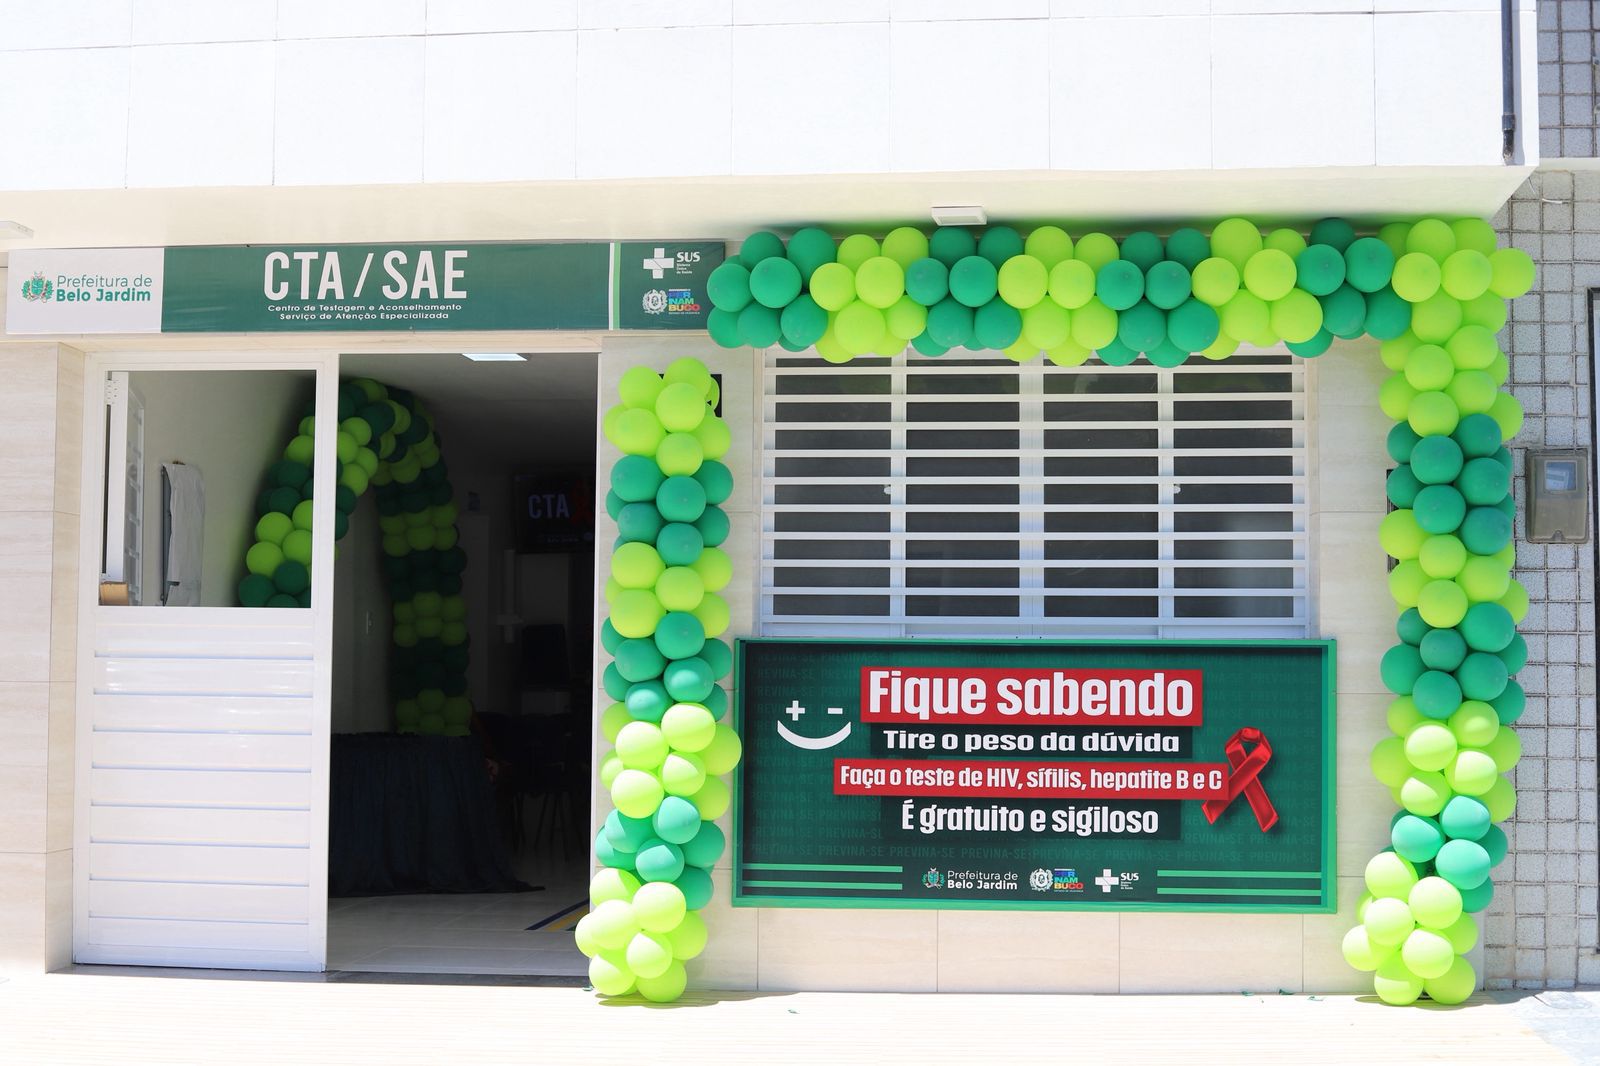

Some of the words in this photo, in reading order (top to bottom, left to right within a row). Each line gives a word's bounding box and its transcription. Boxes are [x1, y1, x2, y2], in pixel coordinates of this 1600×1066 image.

[677, 252, 700, 262] SUS
[57, 274, 128, 288] Prefeitura
[133, 274, 152, 288] de
[264, 251, 345, 301] CTA
[353, 253, 374, 298] /
[382, 250, 468, 300] SAE
[56, 288, 91, 302] Belo
[96, 288, 151, 302] Jardim
[268, 304, 300, 312] Centro
[319, 304, 365, 313] Testagem
[378, 303, 462, 312] Aconselhamento
[280, 312, 316, 321] Serviço
[319, 312, 332, 320] de
[335, 312, 377, 321] Atenção
[380, 312, 449, 321] Especializada
[528, 494, 570, 519] CTA
[870, 670, 986, 720] Fique
[997, 672, 1192, 717] sabendo
[884, 730, 935, 750] Tire
[942, 733, 958, 750] o
[965, 733, 1034, 752] peso
[1041, 732, 1076, 752] da
[1082, 732, 1179, 752] dúvida
[840, 766, 885, 788] Faça
[890, 769, 901, 786] o
[905, 767, 953, 787] teste
[958, 768, 983, 787] de
[987, 769, 1023, 790] HIV,
[1027, 768, 1086, 791] sífilis,
[1090, 769, 1171, 792] hepatite
[1176, 770, 1189, 790] B
[1193, 773, 1205, 790] e
[1209, 770, 1222, 790] C
[902, 799, 914, 830] É
[920, 804, 1025, 834] gratuito
[1030, 810, 1046, 833] e
[1052, 806, 1159, 837] sigiloso
[947, 870, 1000, 880] Prefeitura
[1005, 871, 1018, 880] de
[1120, 872, 1139, 881] SUS
[947, 880, 973, 889] Belo
[977, 880, 1018, 890] Jardim
